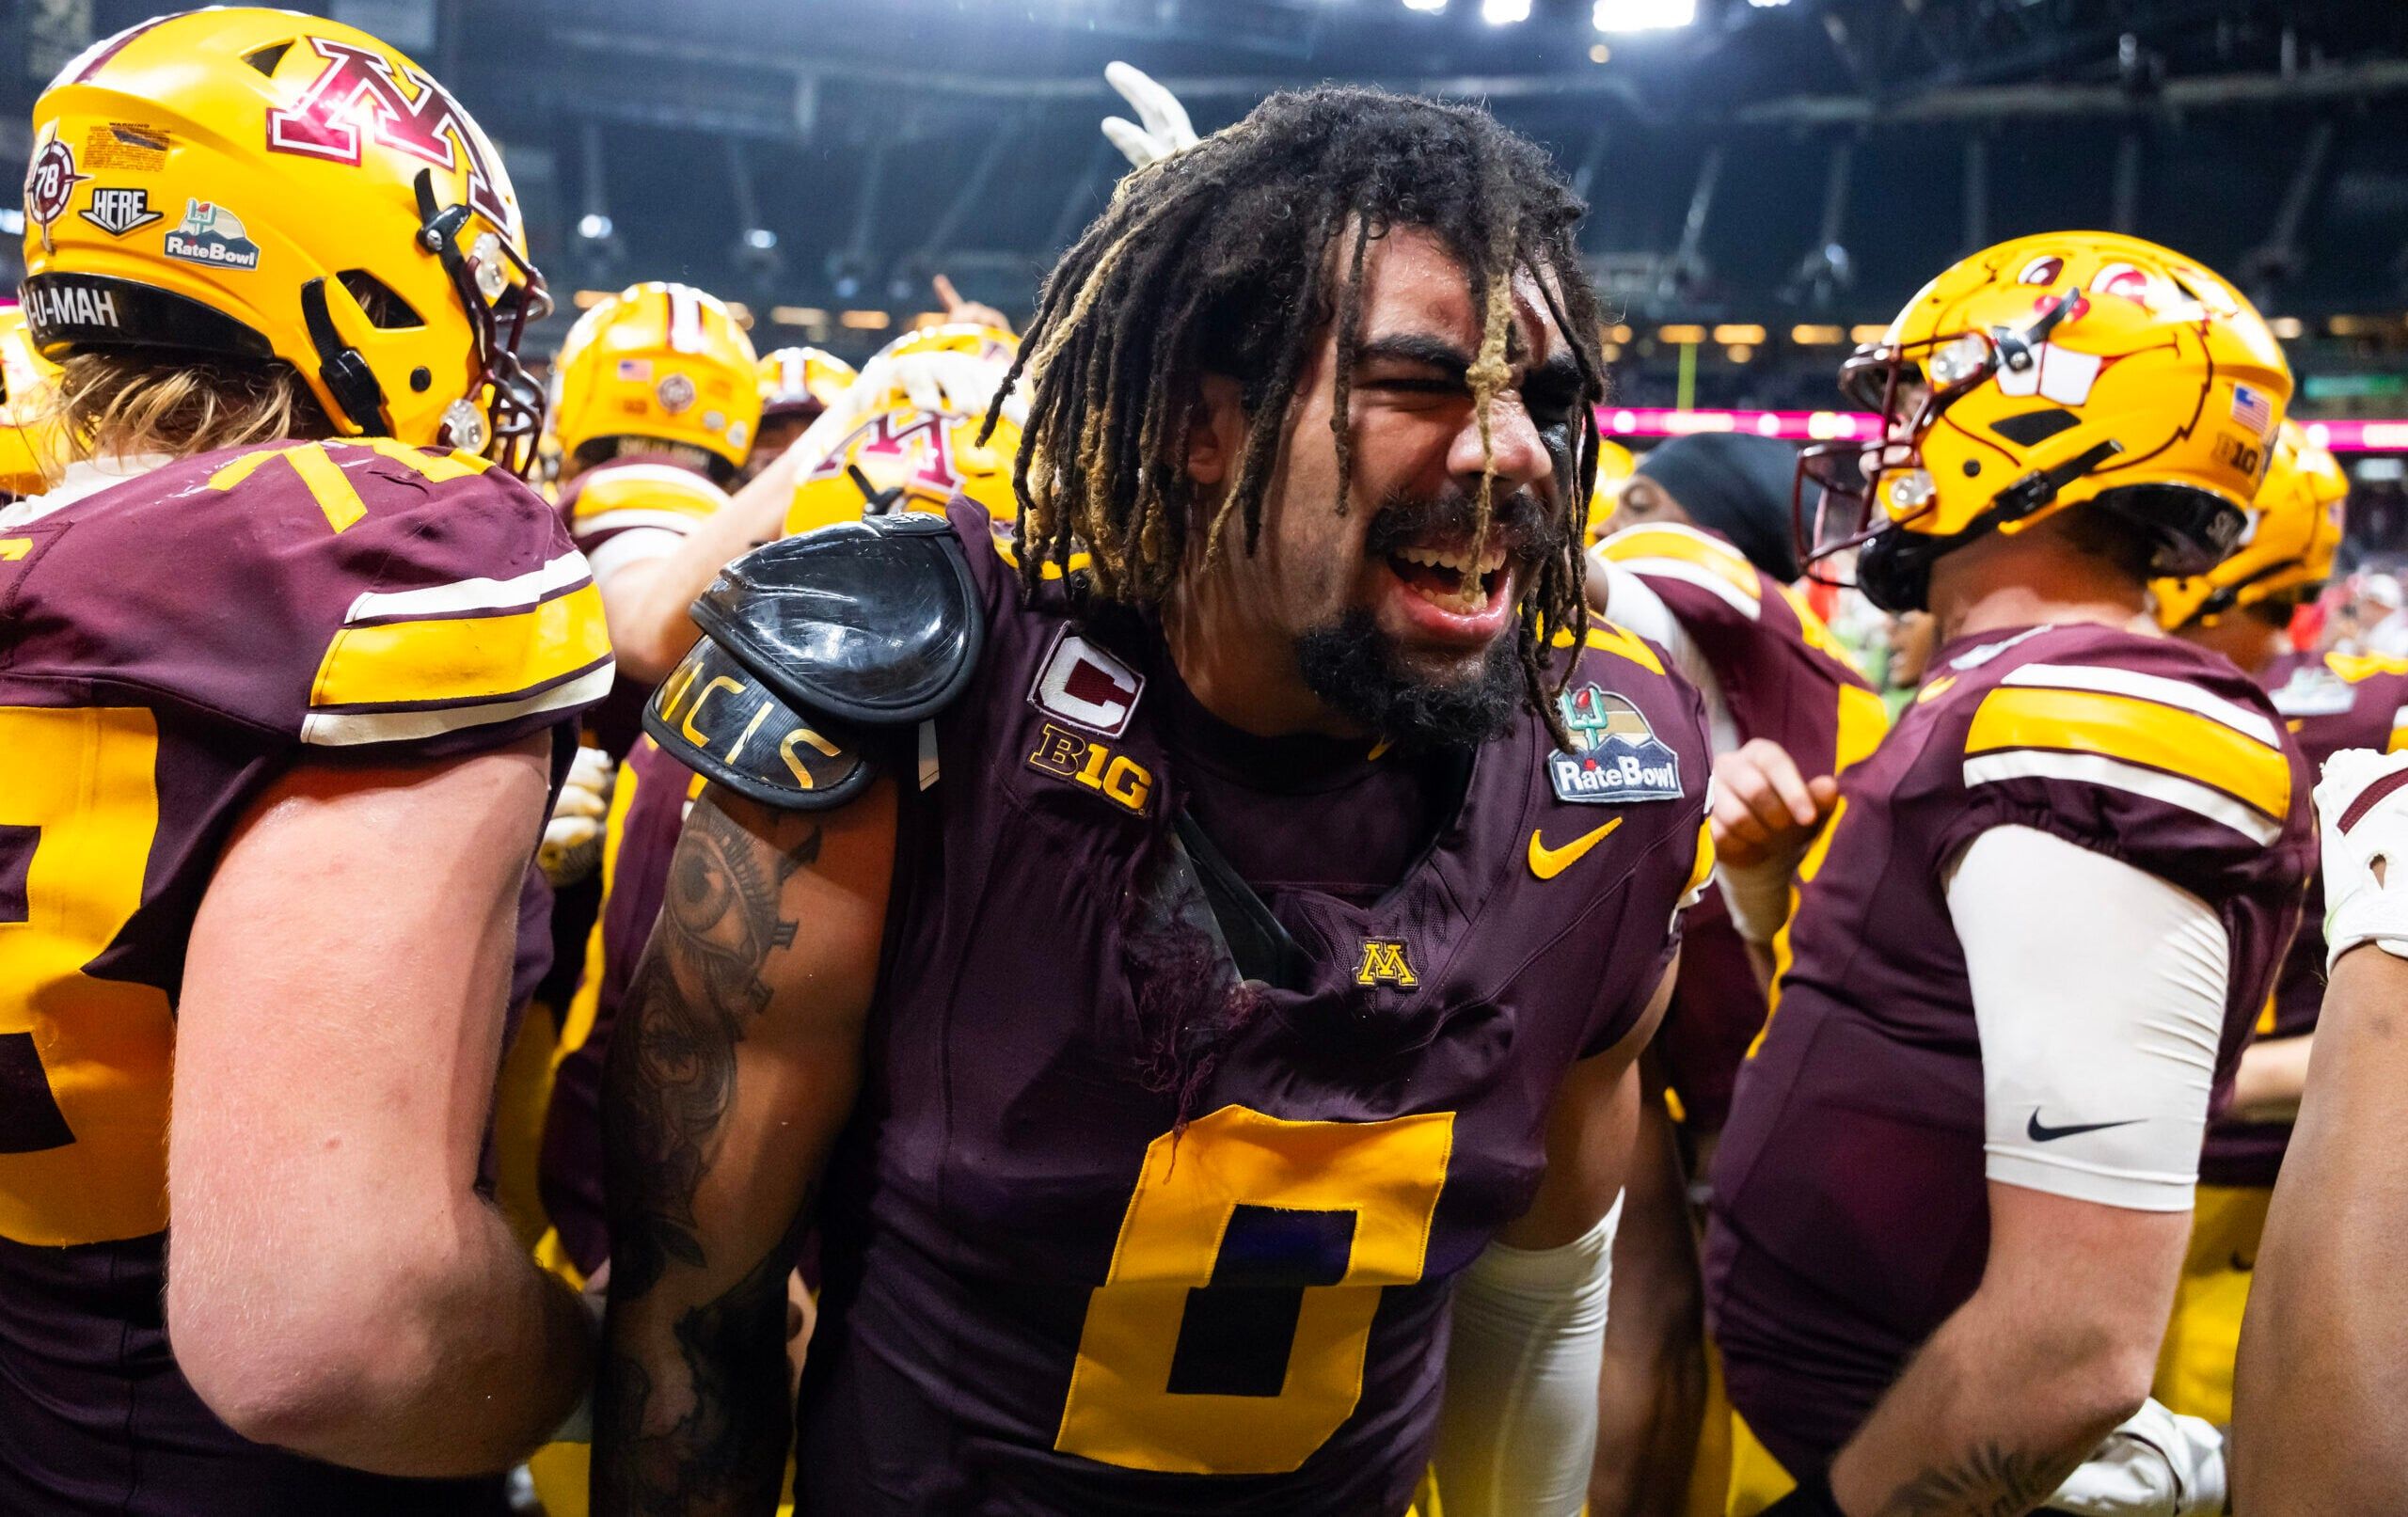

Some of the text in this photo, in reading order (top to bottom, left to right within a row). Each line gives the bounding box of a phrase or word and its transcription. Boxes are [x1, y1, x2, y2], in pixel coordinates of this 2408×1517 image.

[266, 36, 513, 243] M
[34, 163, 60, 198] 78
[94, 190, 146, 231] HERE
[1039, 636, 1136, 728] C
[1356, 940, 1418, 986] M
